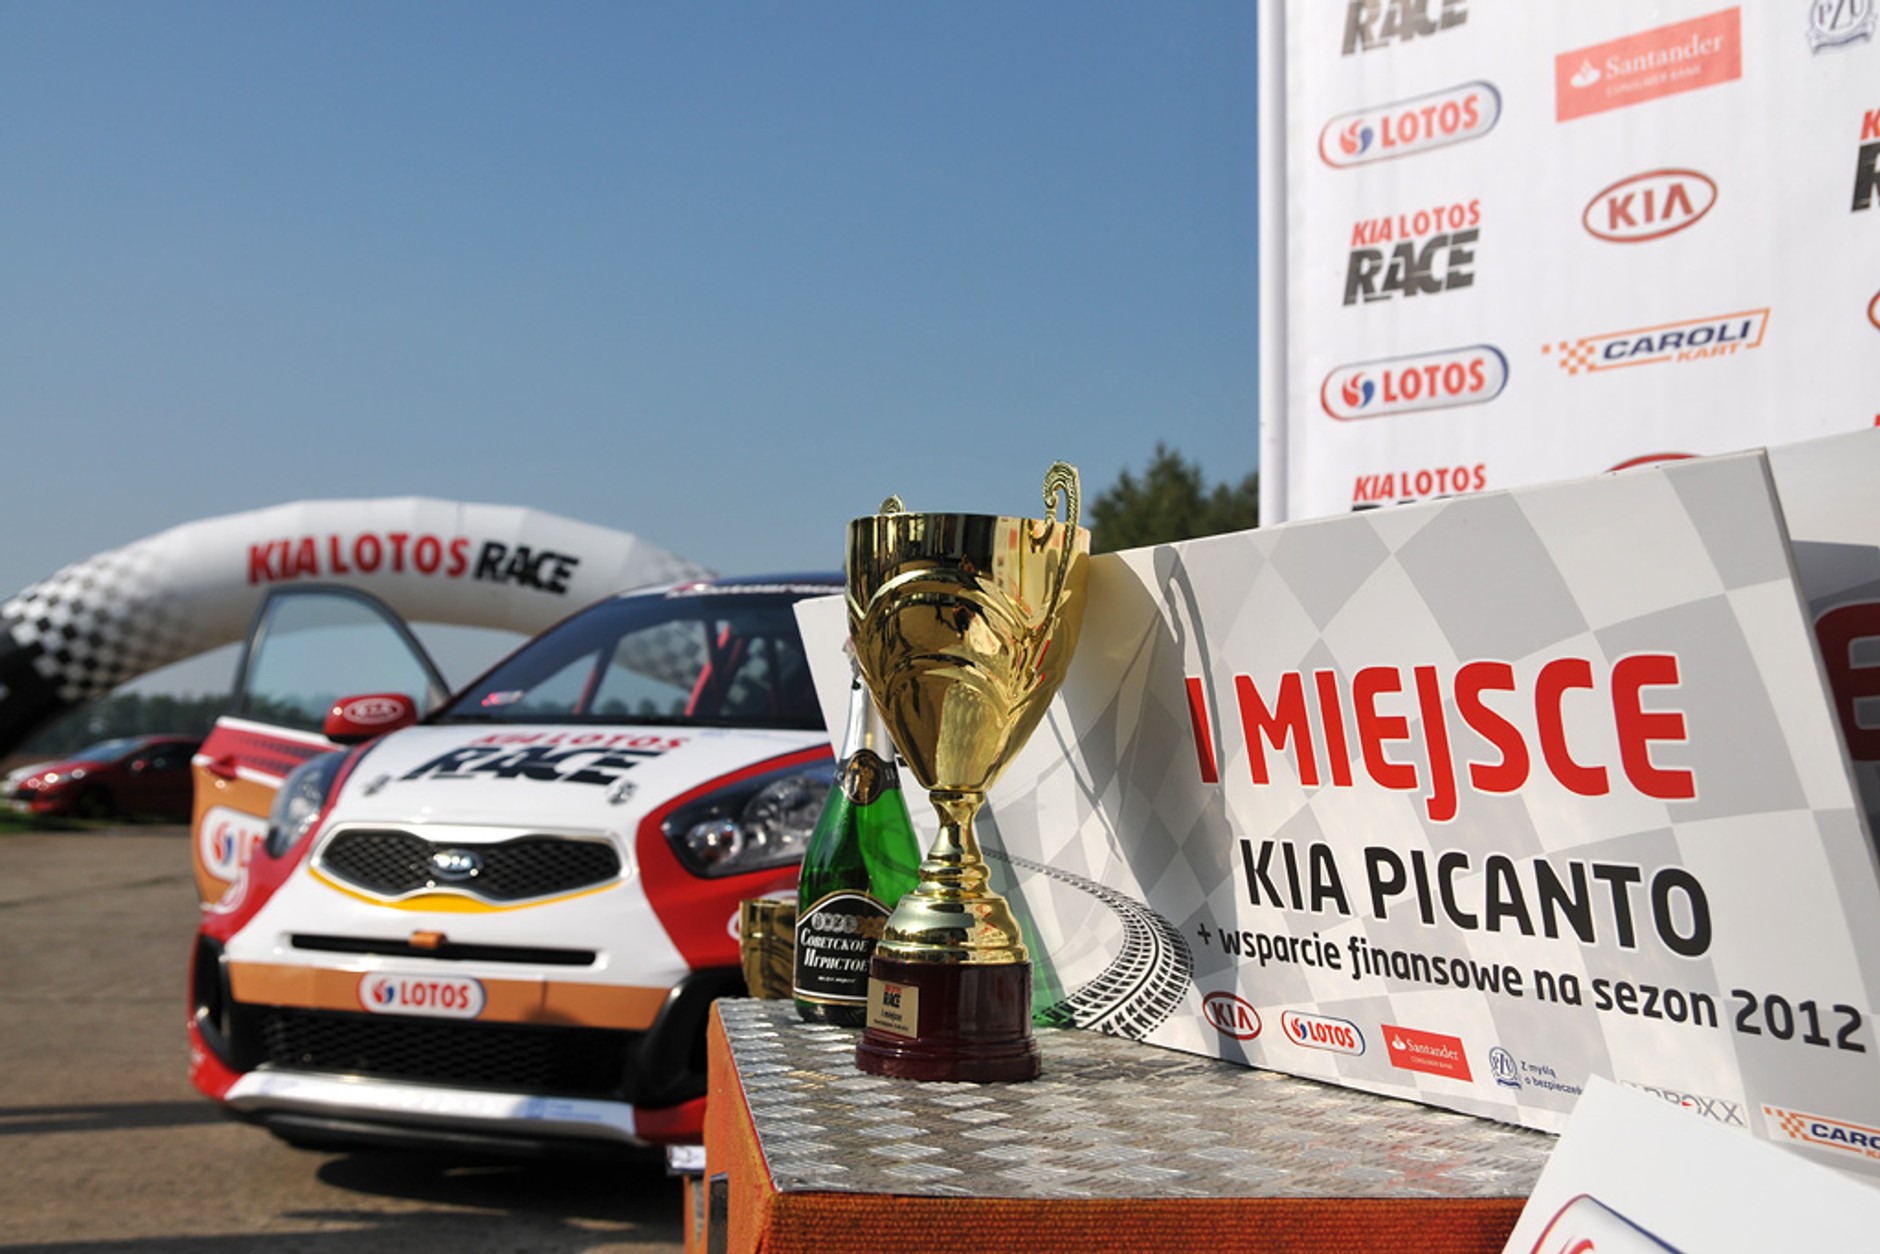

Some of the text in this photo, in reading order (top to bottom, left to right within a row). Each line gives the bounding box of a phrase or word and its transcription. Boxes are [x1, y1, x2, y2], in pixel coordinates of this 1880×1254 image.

[1605, 31, 1724, 80] Santander
[1381, 93, 1479, 148] LOTOS
[1351, 199, 1481, 247] KIA LOTOS
[1608, 182, 1694, 231] KIA
[1343, 228, 1480, 306] RACE
[1603, 318, 1752, 360] CAROLI
[1677, 341, 1741, 363] KART
[1383, 358, 1486, 403] LOTOS
[1353, 464, 1486, 502] KIA LOTOS
[247, 532, 580, 596] KIA LOTOS RACE
[547, 732, 690, 750] LOTOS
[1185, 676, 1219, 784] I
[1234, 653, 1695, 822] MIEJSCE
[398, 745, 668, 786] RACE
[1239, 839, 1712, 958] KIA PICANTO
[400, 977, 469, 1010] LOTOS
[1197, 922, 1867, 1053] + wsparcie finansowe na sezon 2012
[1211, 1003, 1254, 1031] KIA
[1308, 1020, 1355, 1049] LOTOS
[1406, 1038, 1458, 1060] Santander
